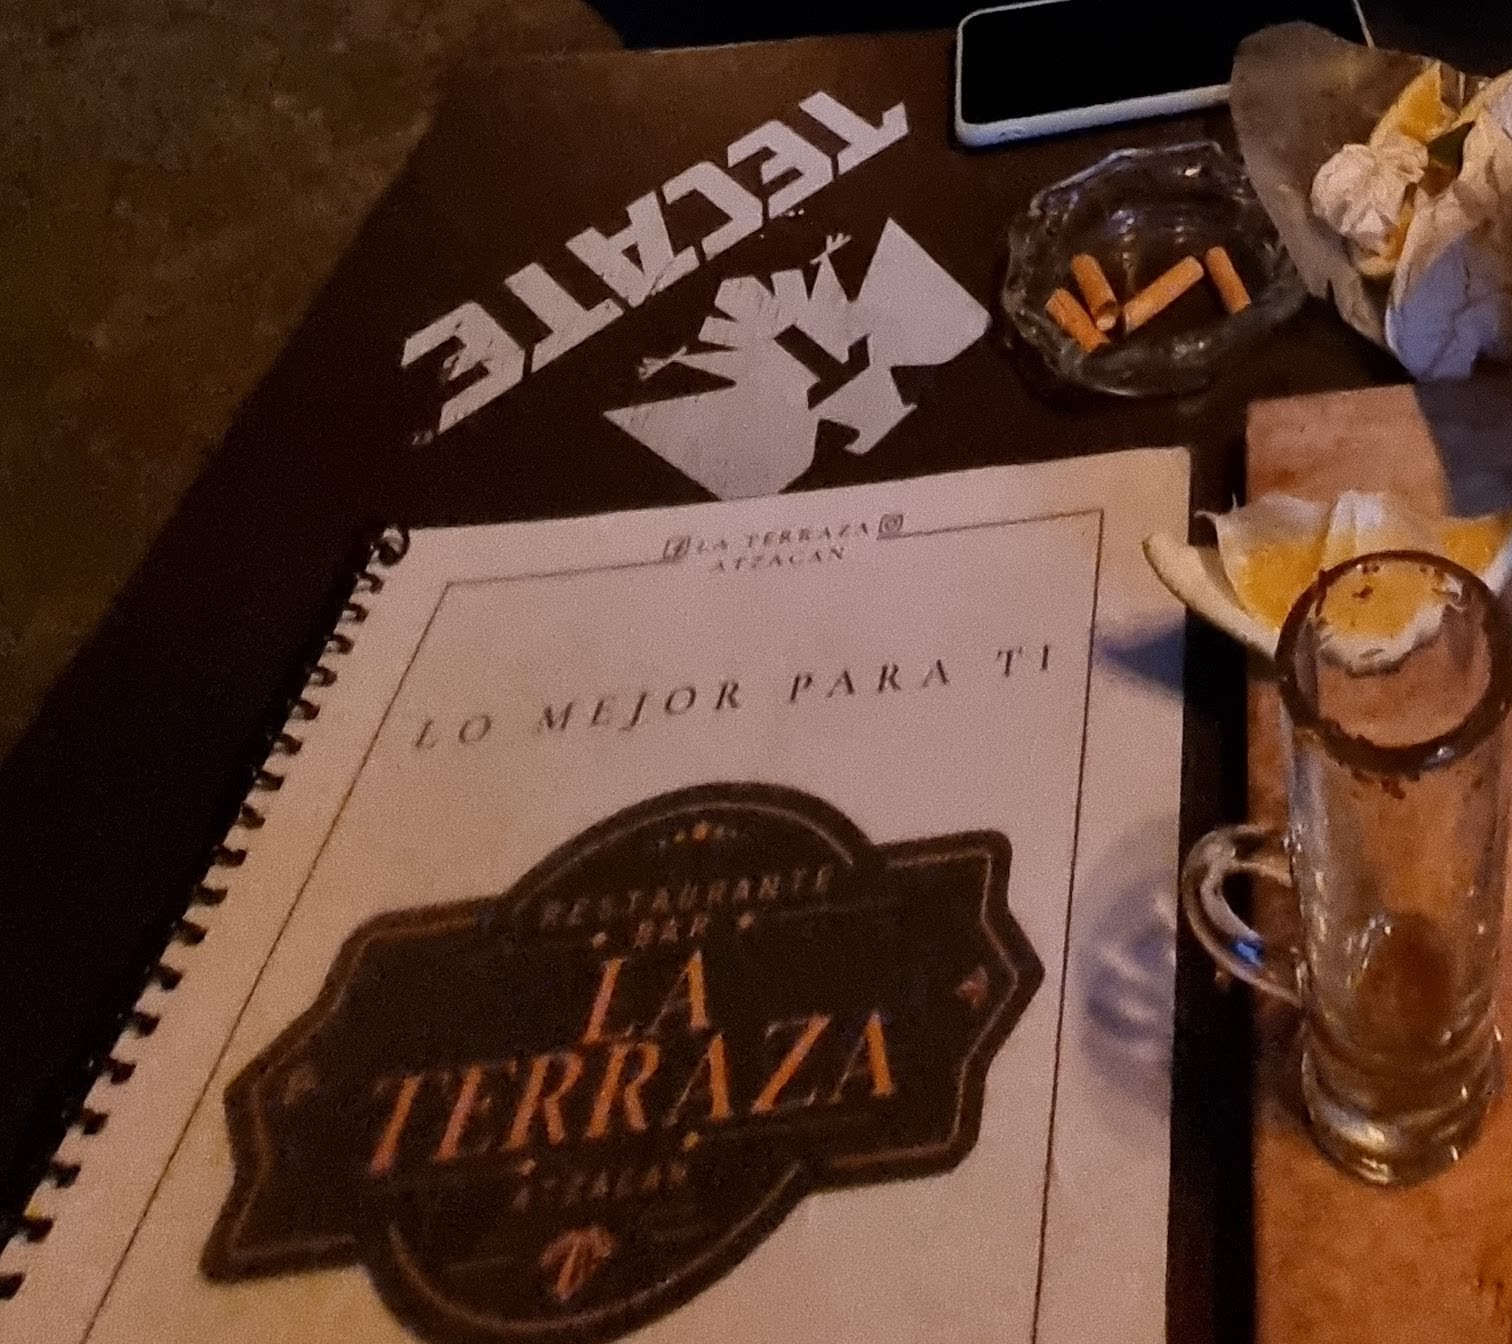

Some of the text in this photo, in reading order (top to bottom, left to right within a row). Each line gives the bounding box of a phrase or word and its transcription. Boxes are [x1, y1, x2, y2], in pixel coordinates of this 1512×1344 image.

[402, 90, 909, 433] TECATE
[747, 522, 868, 548] TERRAZA
[414, 643, 1055, 751] LO MEJOR PARA TI
[584, 951, 710, 1043] LA
[369, 1012, 895, 1175] TERRAZA
